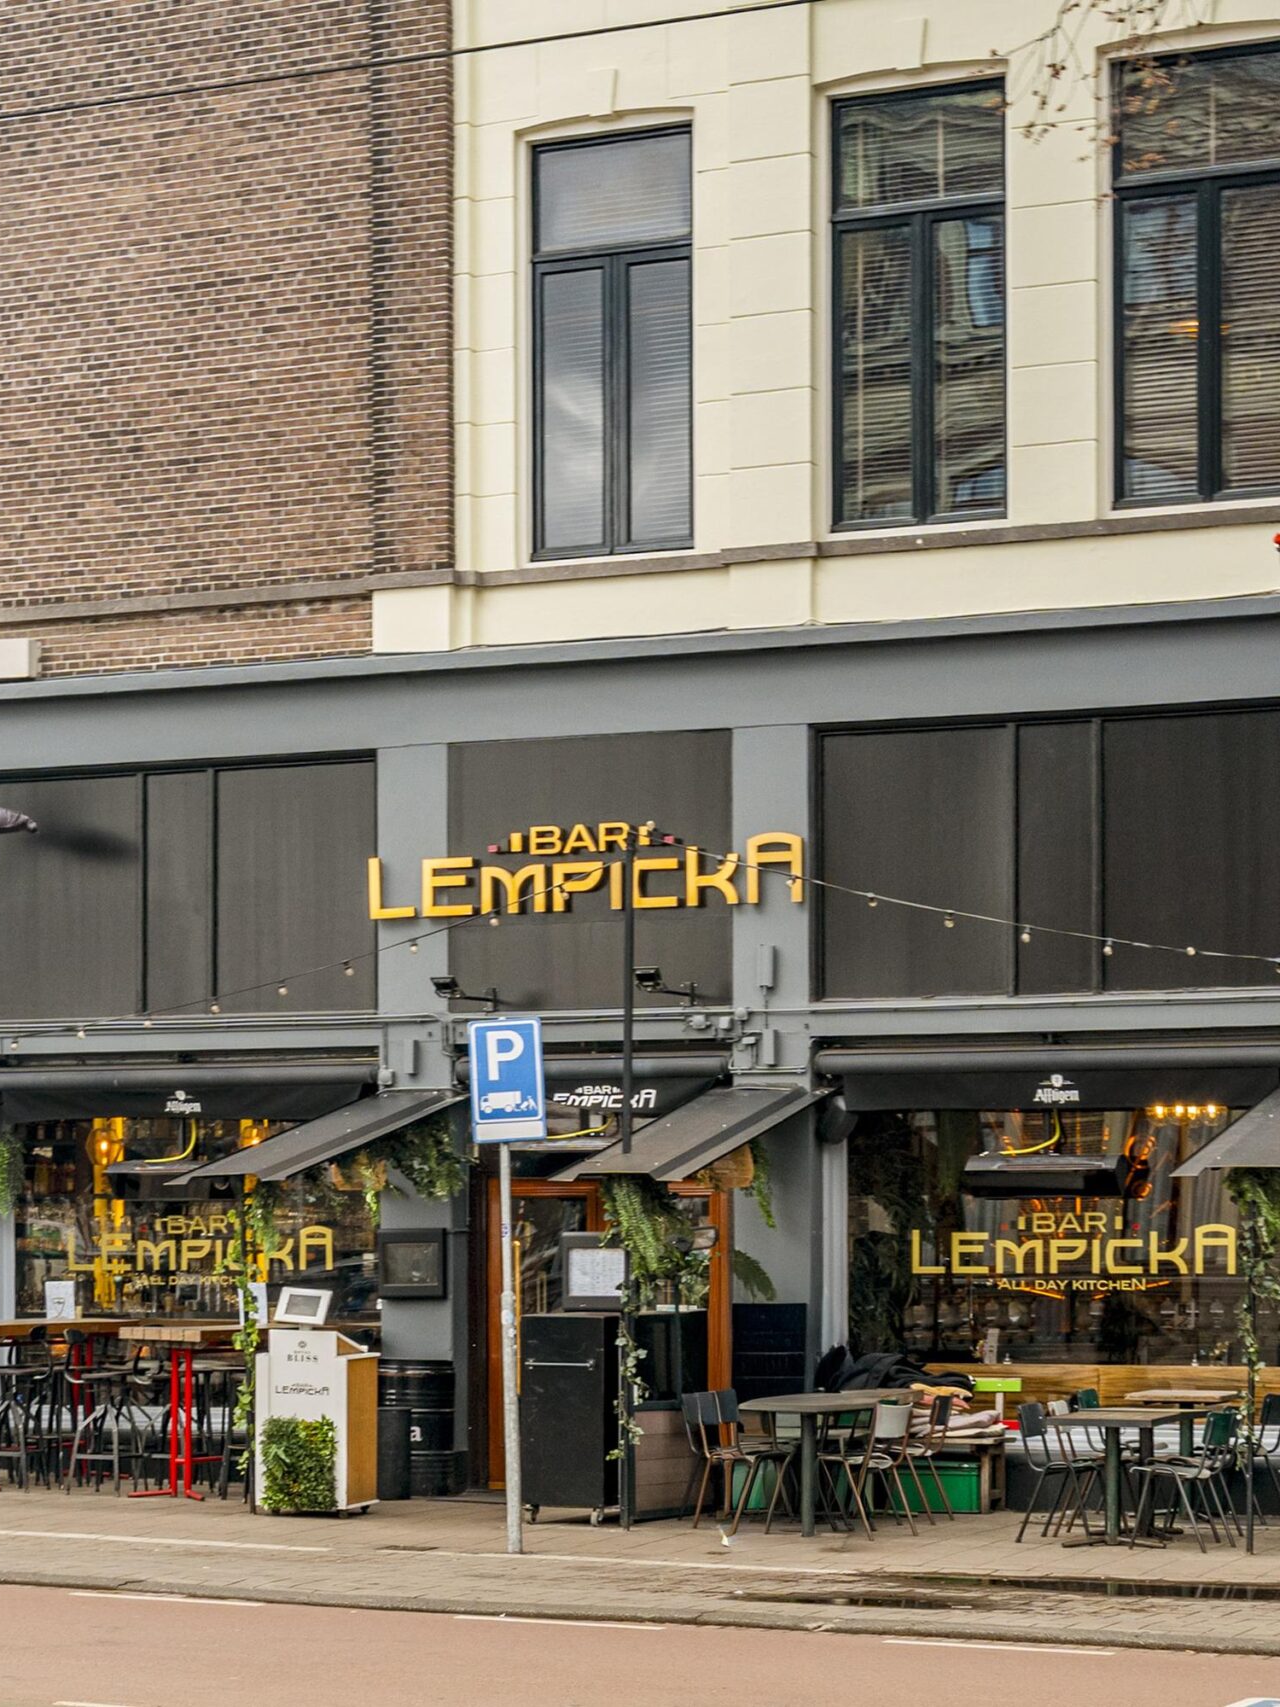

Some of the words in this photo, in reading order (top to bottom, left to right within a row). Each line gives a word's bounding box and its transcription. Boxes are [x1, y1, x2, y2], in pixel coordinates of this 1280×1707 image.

[529, 821, 630, 855] BAR
[368, 832, 804, 920] LEMPICKA
[485, 1029, 525, 1082] P
[552, 1089, 657, 1109] EMPICA
[583, 1085, 612, 1095] BAR
[167, 1215, 228, 1234] BAR
[1032, 1212, 1107, 1233] BAR
[911, 1223, 1236, 1275] LEMPICKA
[998, 1278, 1030, 1290] ALL
[1035, 1280, 1069, 1290] DAY
[1072, 1278, 1146, 1291] KITCHEN
